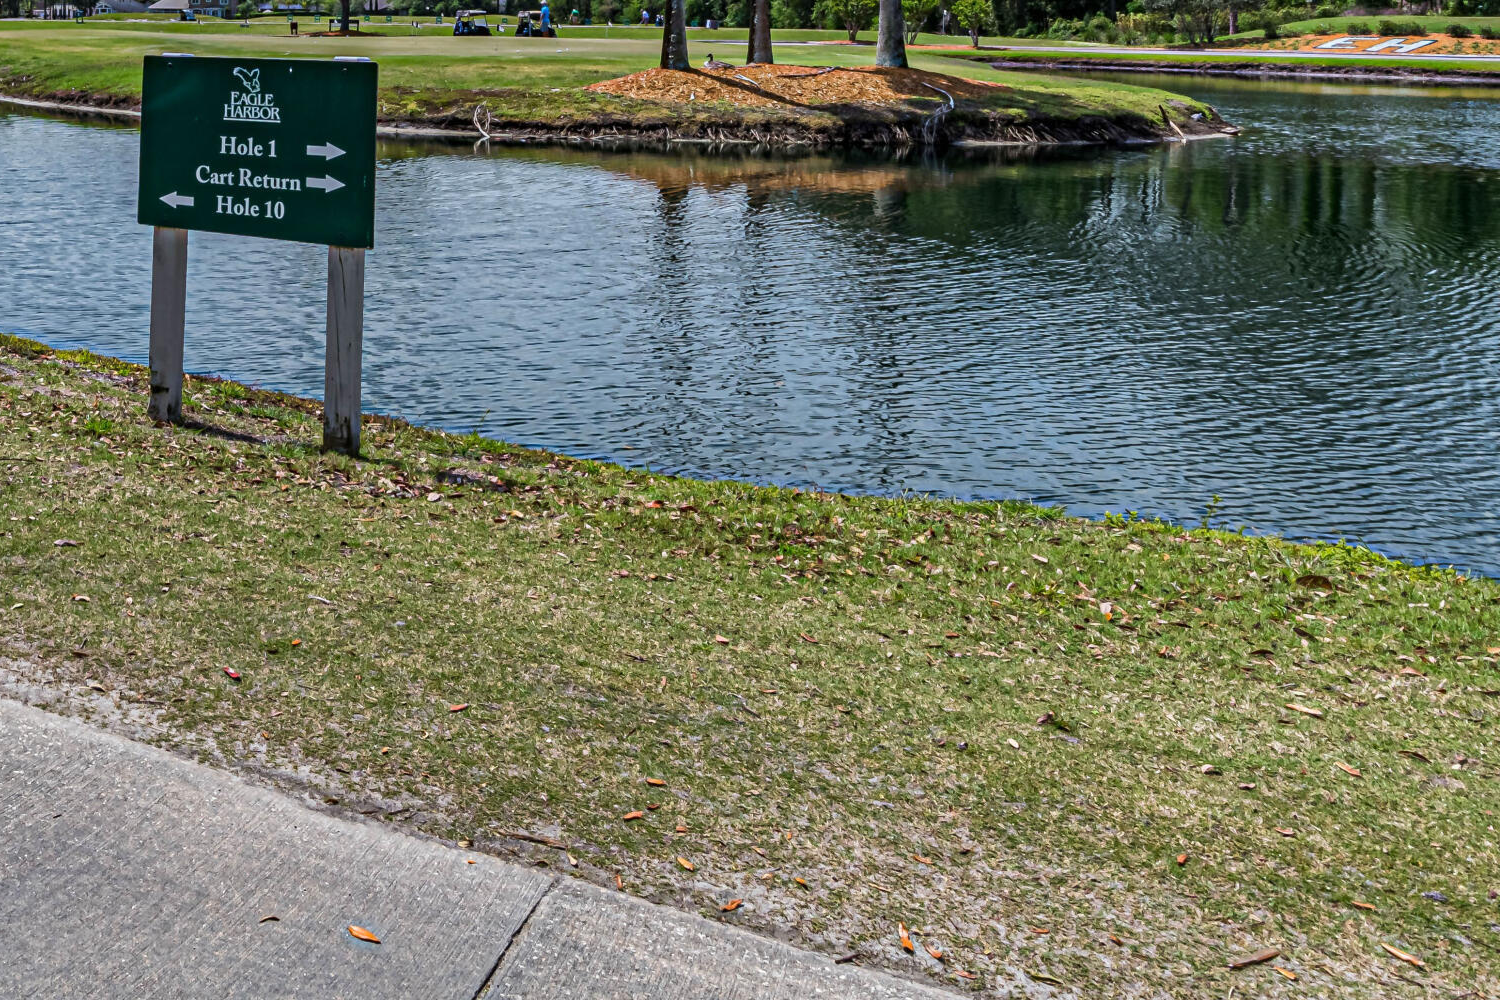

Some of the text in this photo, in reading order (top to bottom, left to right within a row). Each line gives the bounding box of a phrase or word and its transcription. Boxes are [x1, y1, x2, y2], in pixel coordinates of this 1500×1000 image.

[1313, 36, 1437, 53] EH
[231, 91, 274, 106] EAGLE
[224, 104, 280, 119] HARBOR
[220, 136, 277, 157] Hole 1
[196, 165, 301, 191] Cart Return
[216, 196, 285, 219] Hole 10
